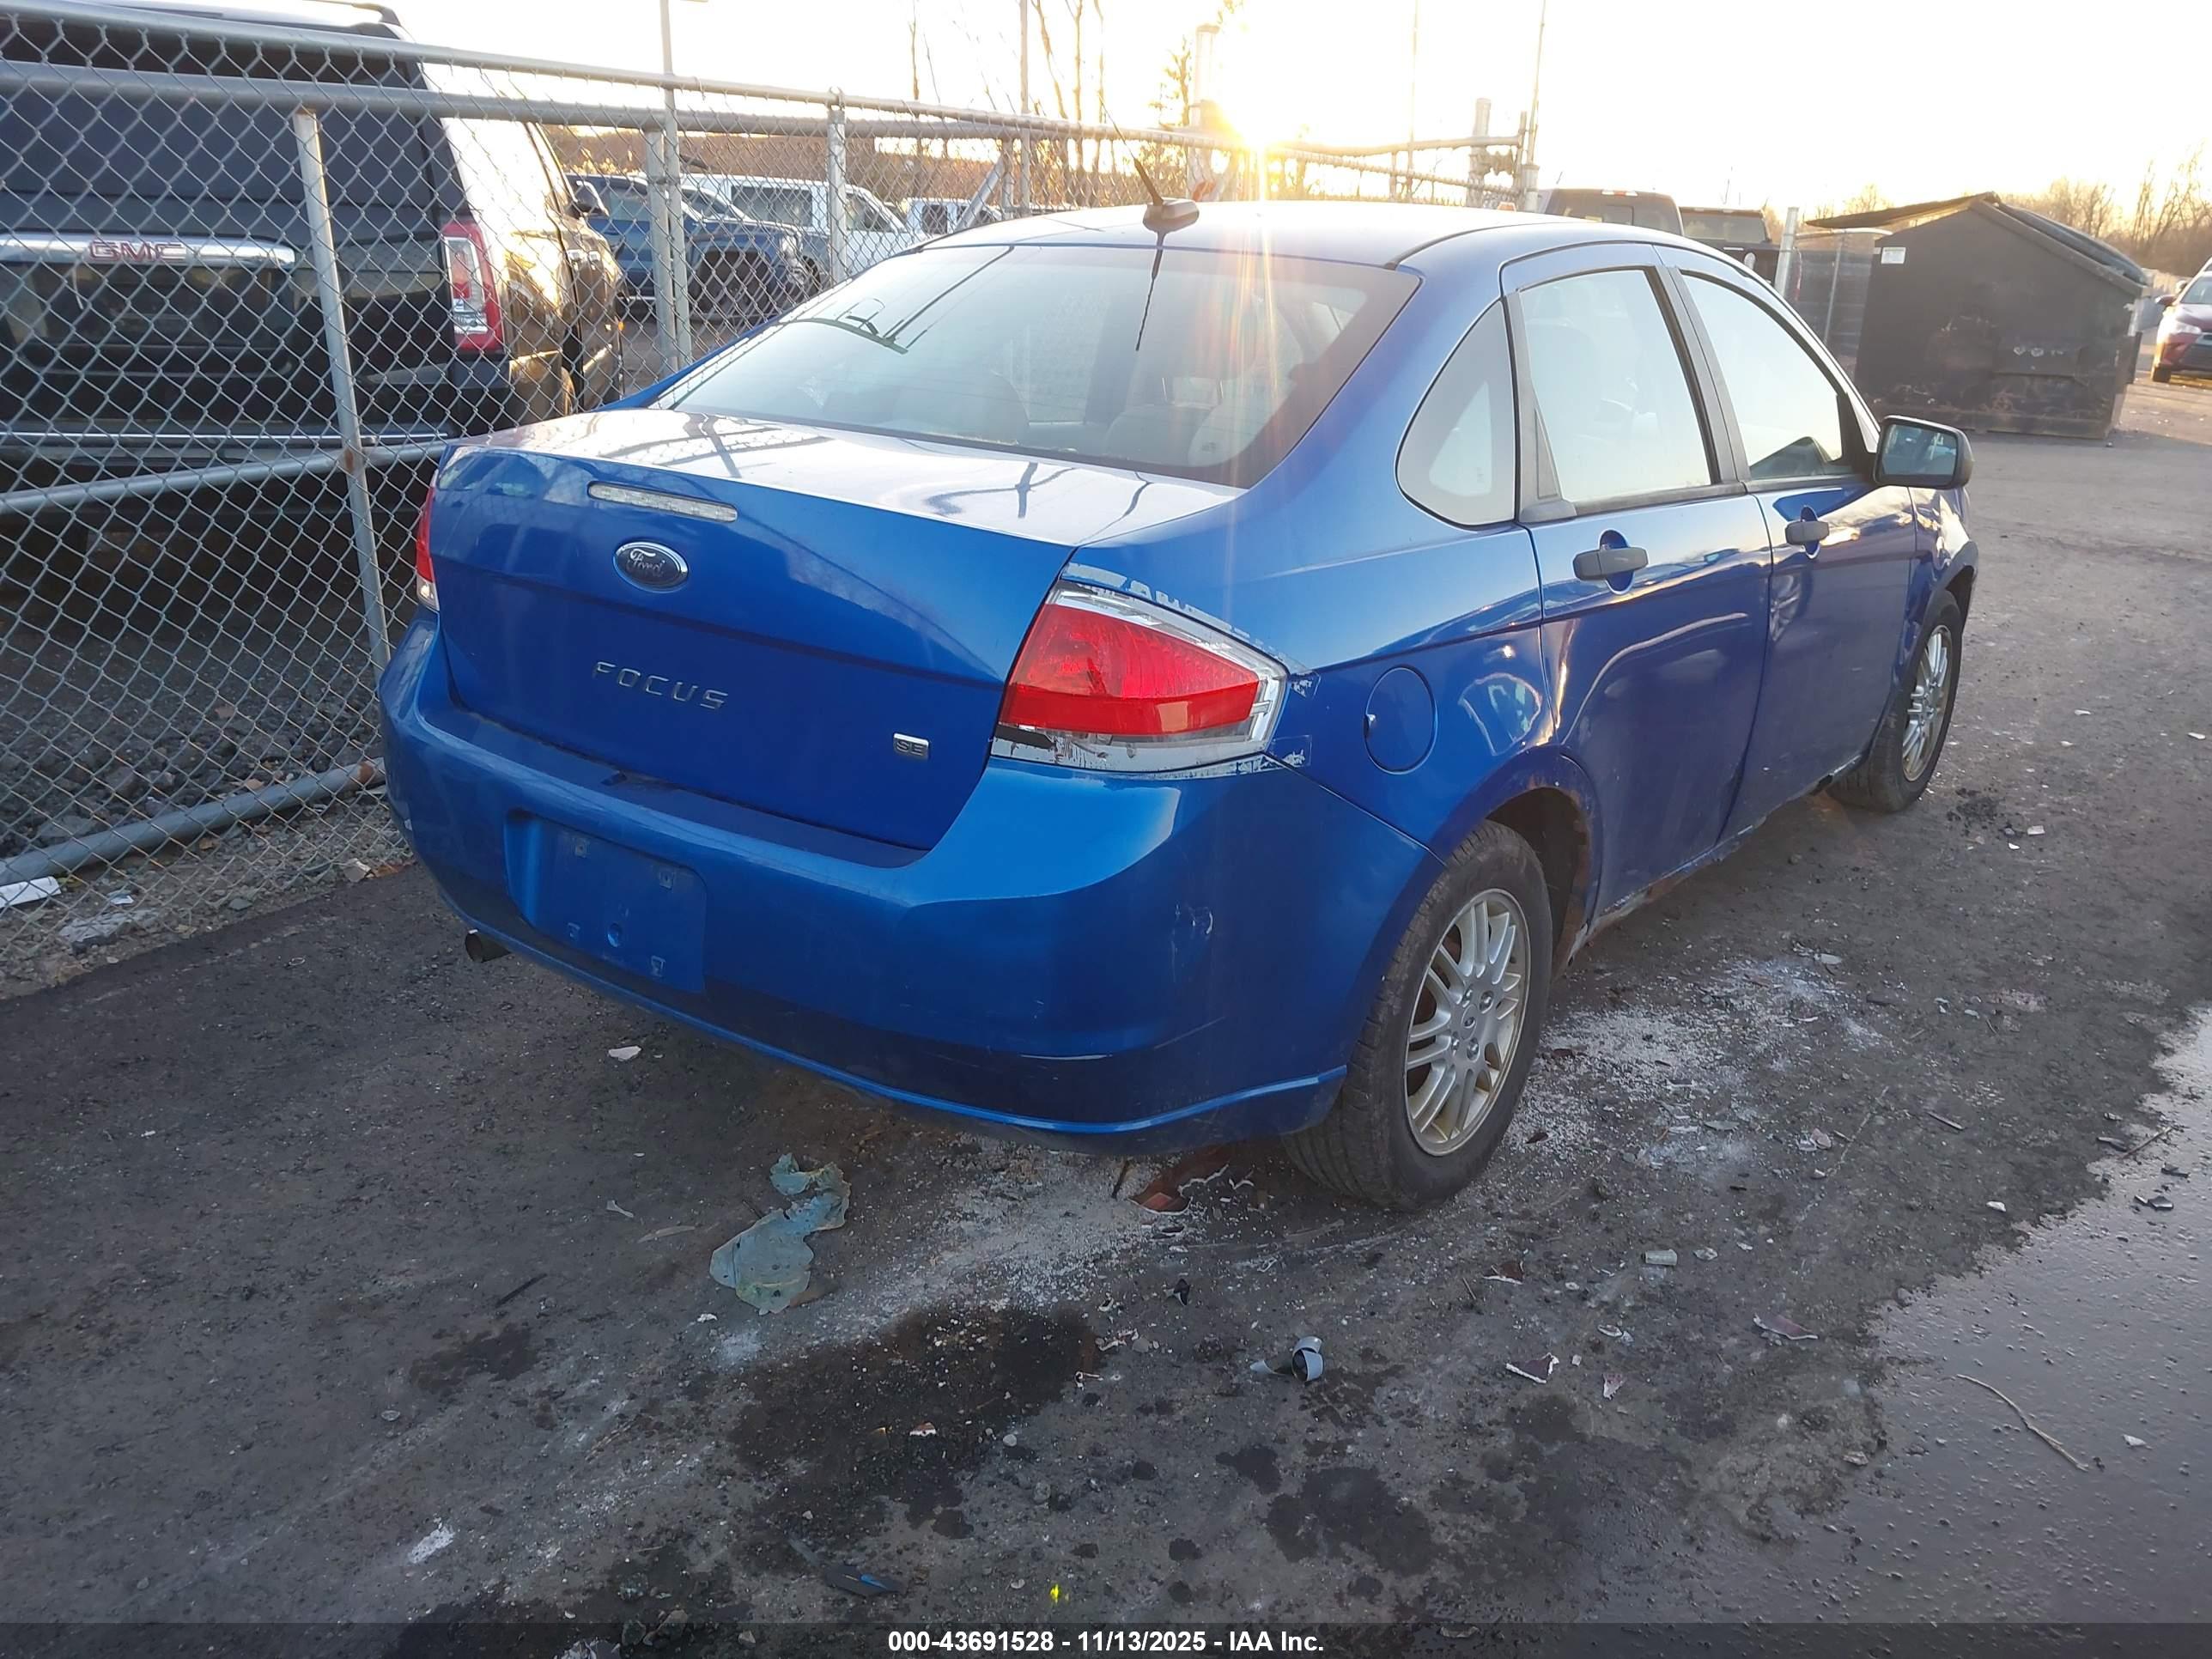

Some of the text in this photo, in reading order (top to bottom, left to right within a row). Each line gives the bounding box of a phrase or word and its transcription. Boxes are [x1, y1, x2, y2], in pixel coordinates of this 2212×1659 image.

[90, 240, 186, 261] GMC
[592, 660, 729, 711] FOCUS
[895, 738, 925, 757] SE
